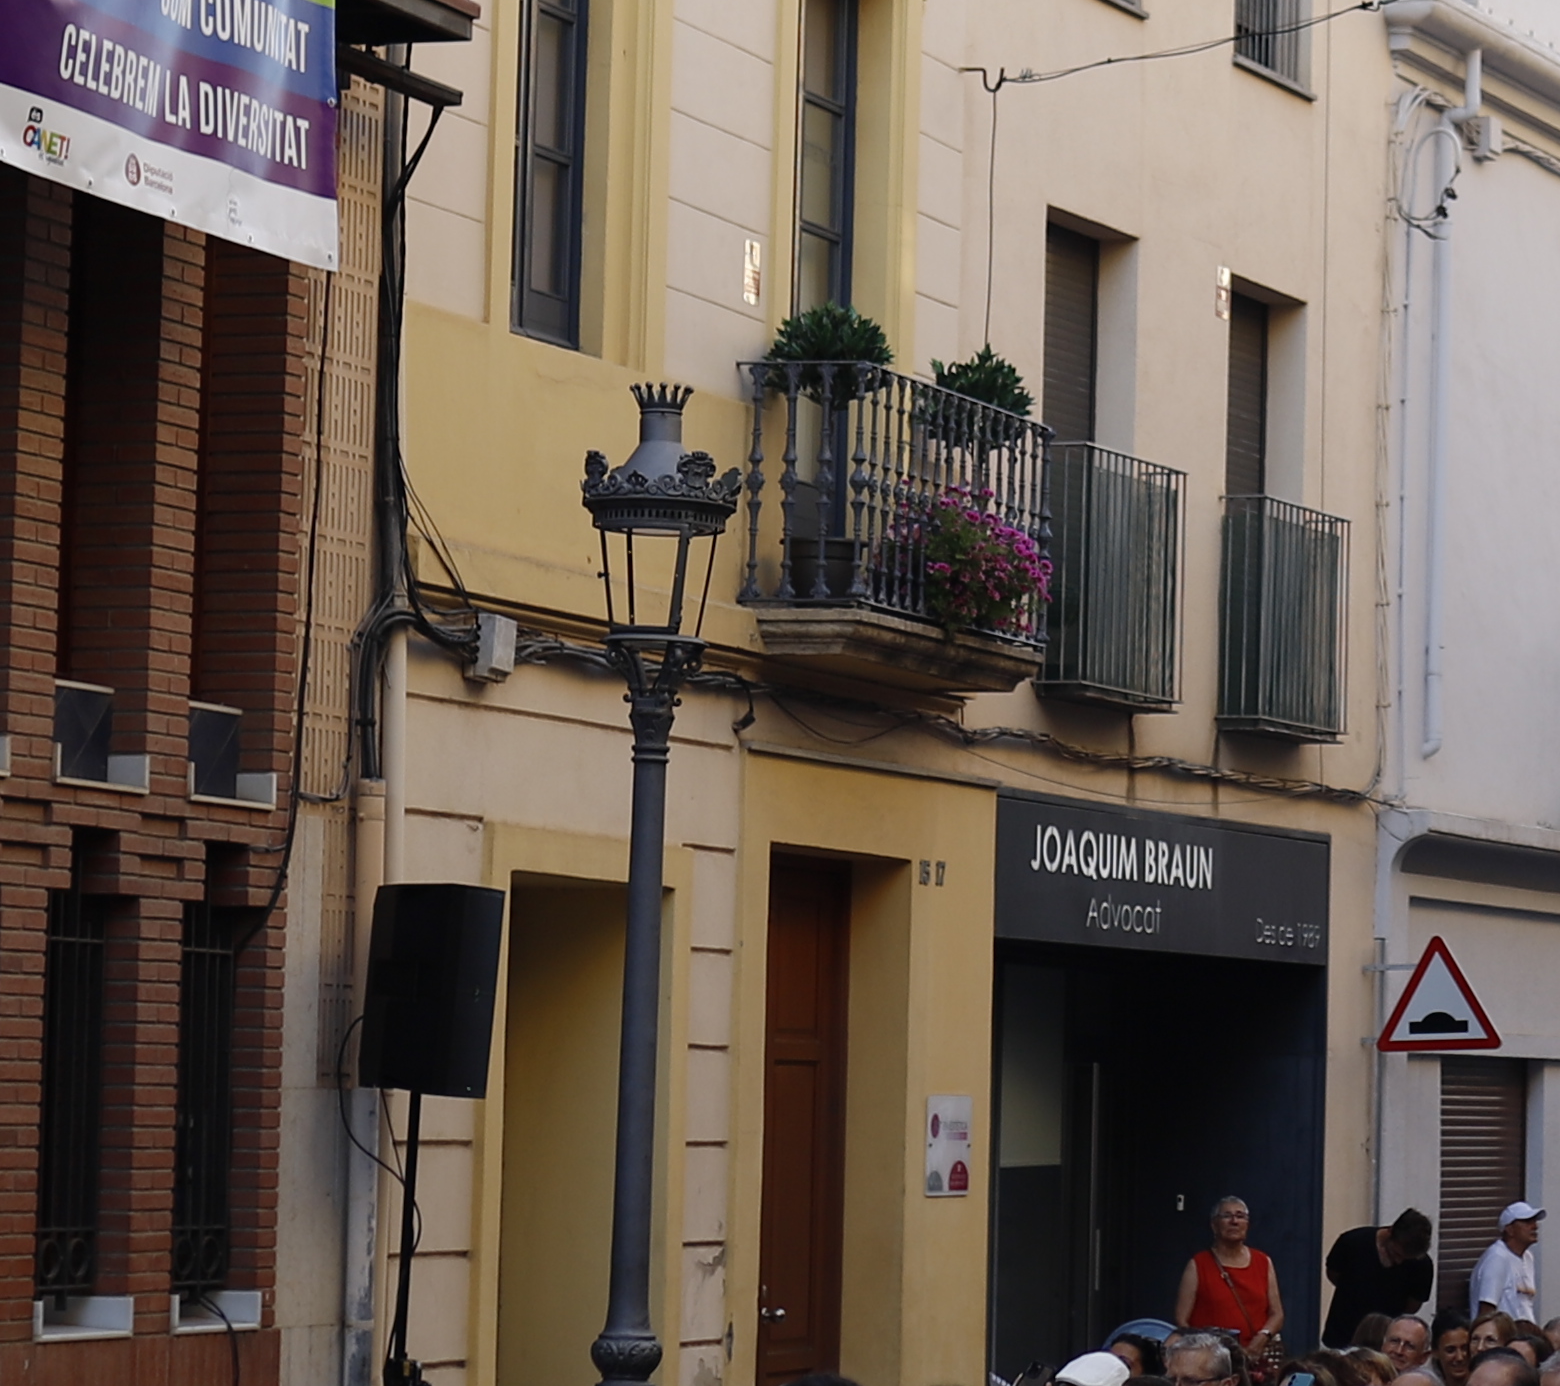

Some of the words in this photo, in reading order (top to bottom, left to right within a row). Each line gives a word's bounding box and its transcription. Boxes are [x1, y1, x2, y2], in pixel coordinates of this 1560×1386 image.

[59, 23, 161, 118] CELEBREM
[164, 69, 192, 130] LA
[199, 80, 310, 170] DIVERSITAT
[23, 124, 71, 160] CANET!
[1031, 824, 1138, 881] JOAQUIM
[1144, 838, 1214, 890] BRAUN
[1086, 894, 1162, 935] Advocat
